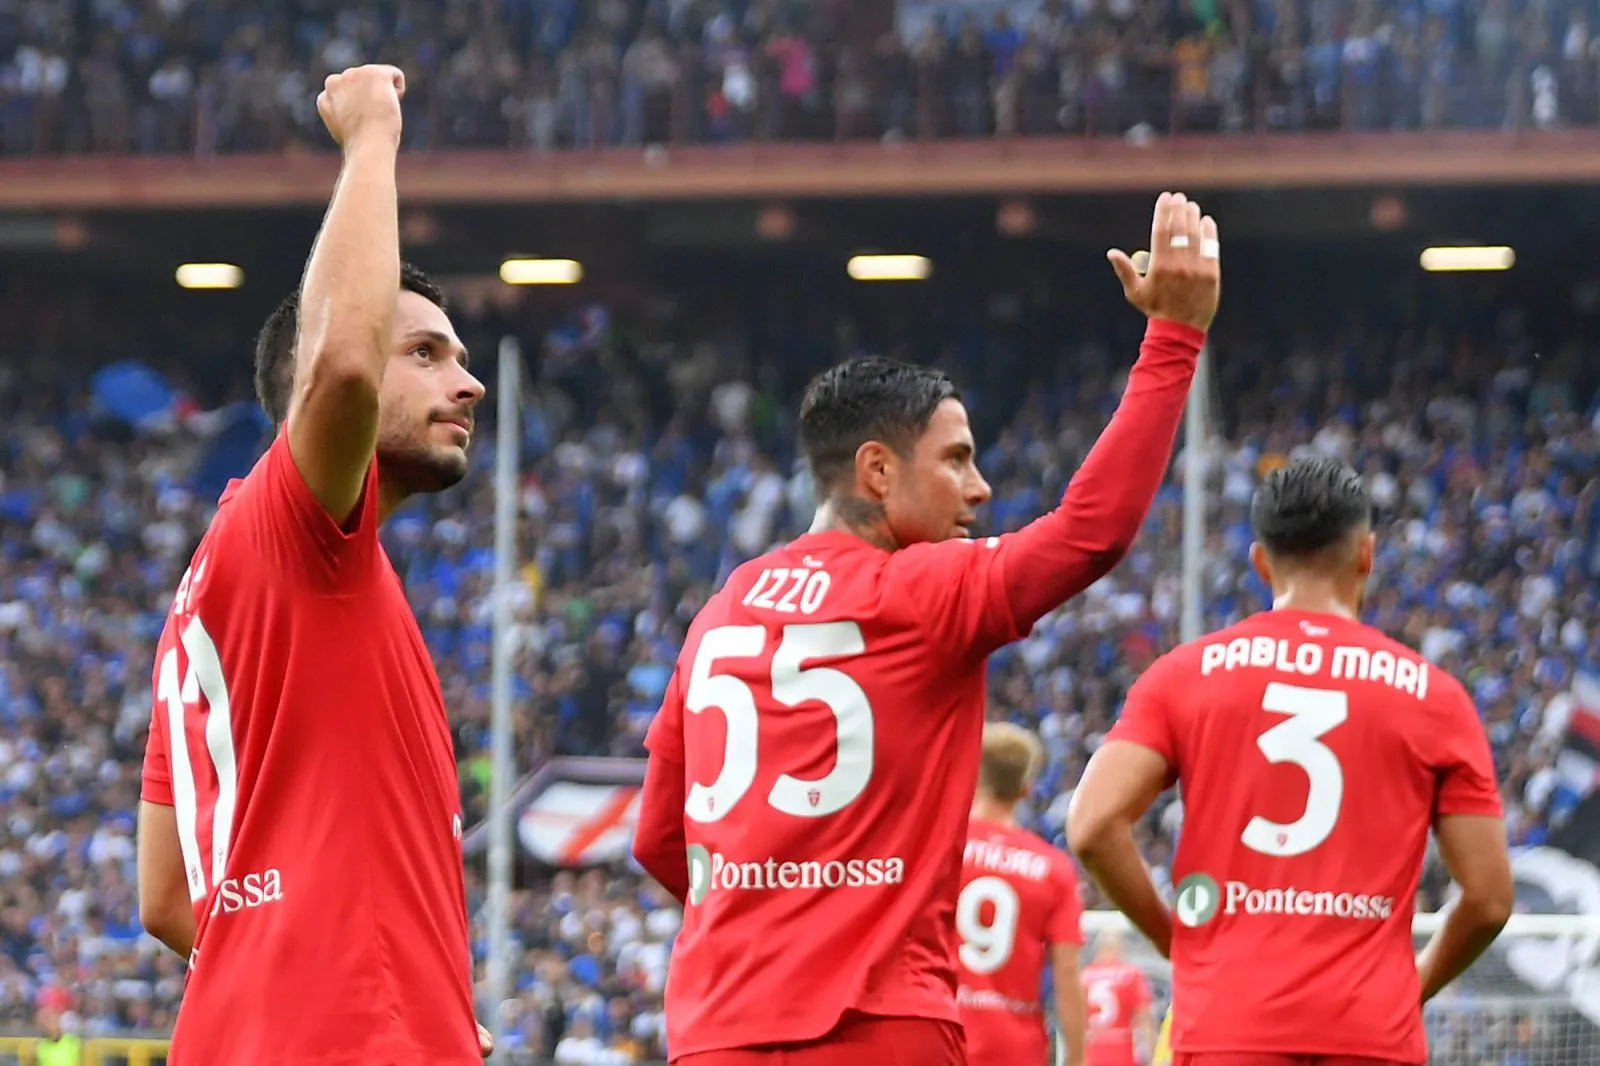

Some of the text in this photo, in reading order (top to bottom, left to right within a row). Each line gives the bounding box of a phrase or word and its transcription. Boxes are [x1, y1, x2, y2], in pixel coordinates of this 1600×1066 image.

[742, 568, 831, 615] IZZO
[1201, 635, 1429, 700] PABLO MARI
[684, 620, 875, 824] 55
[1241, 681, 1349, 858] 3
[710, 855, 904, 892] Pontenossa
[1224, 881, 1394, 919] Pontenossa
[956, 875, 1021, 976] 9
[1087, 979, 1120, 1026] 5
